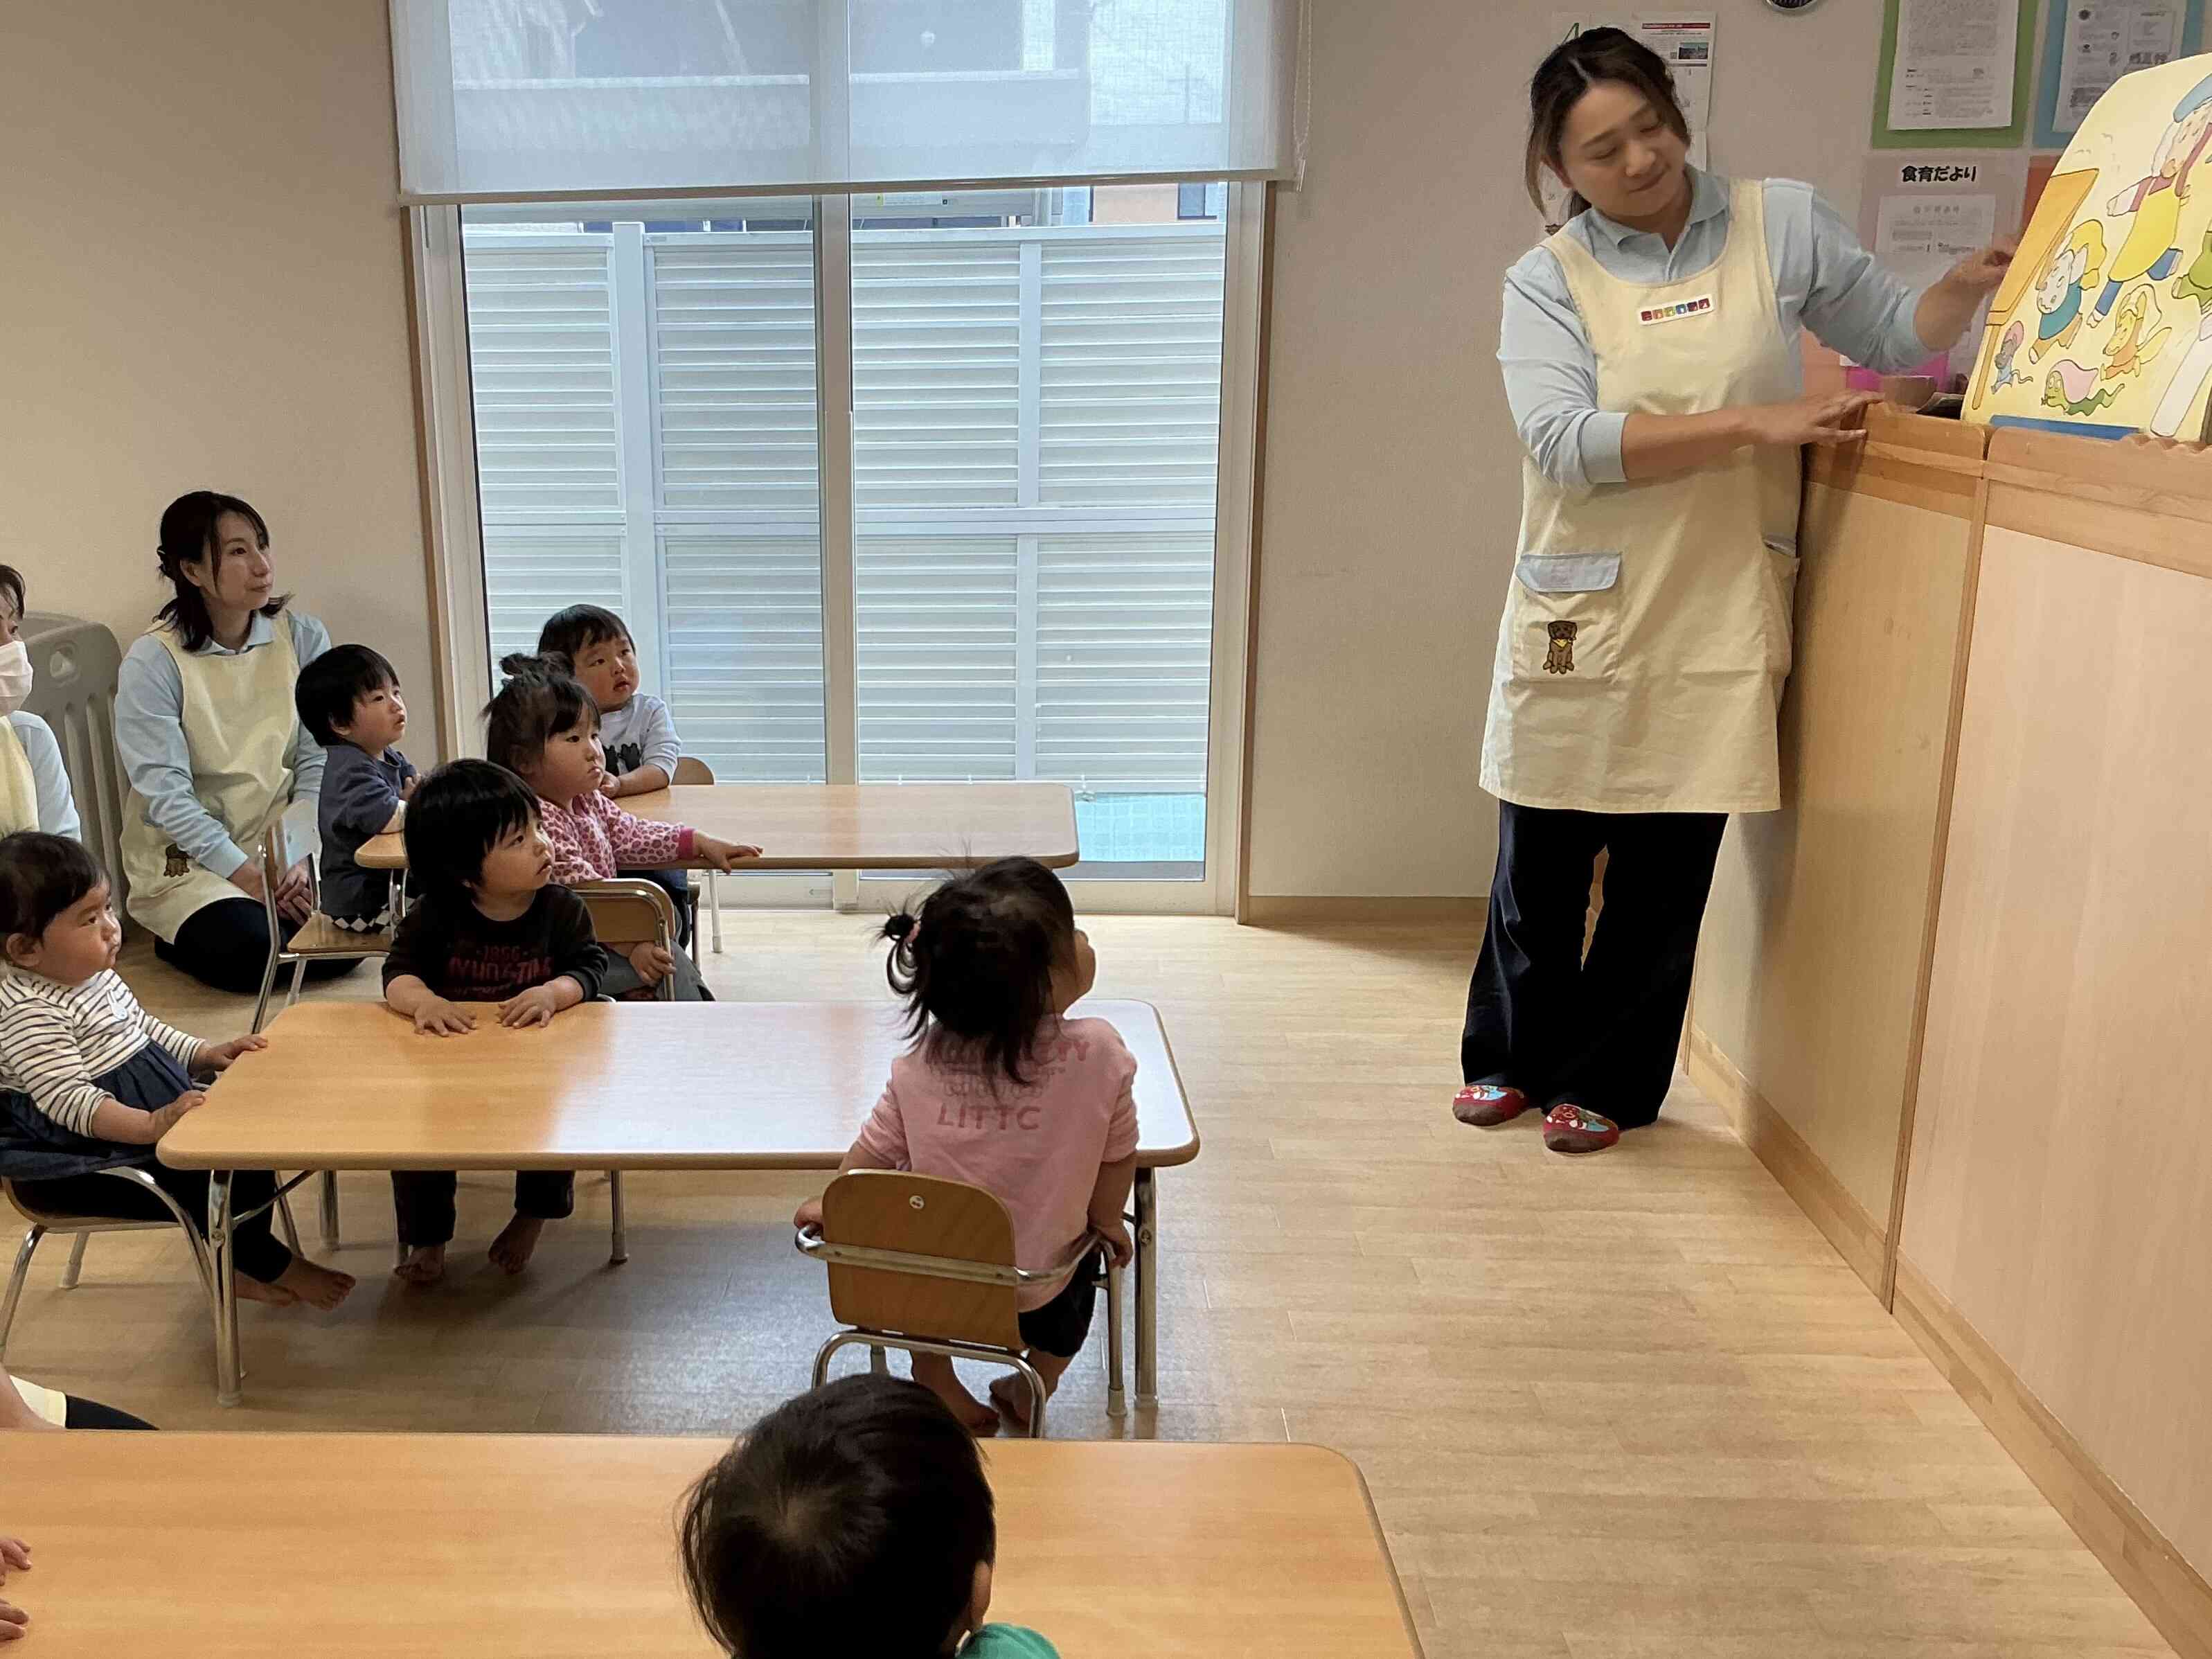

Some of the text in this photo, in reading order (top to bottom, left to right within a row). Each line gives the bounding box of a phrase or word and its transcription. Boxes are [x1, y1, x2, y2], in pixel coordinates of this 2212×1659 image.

[1902, 166, 1977, 182] 食育だより
[936, 1102, 1042, 1130] LITTC
